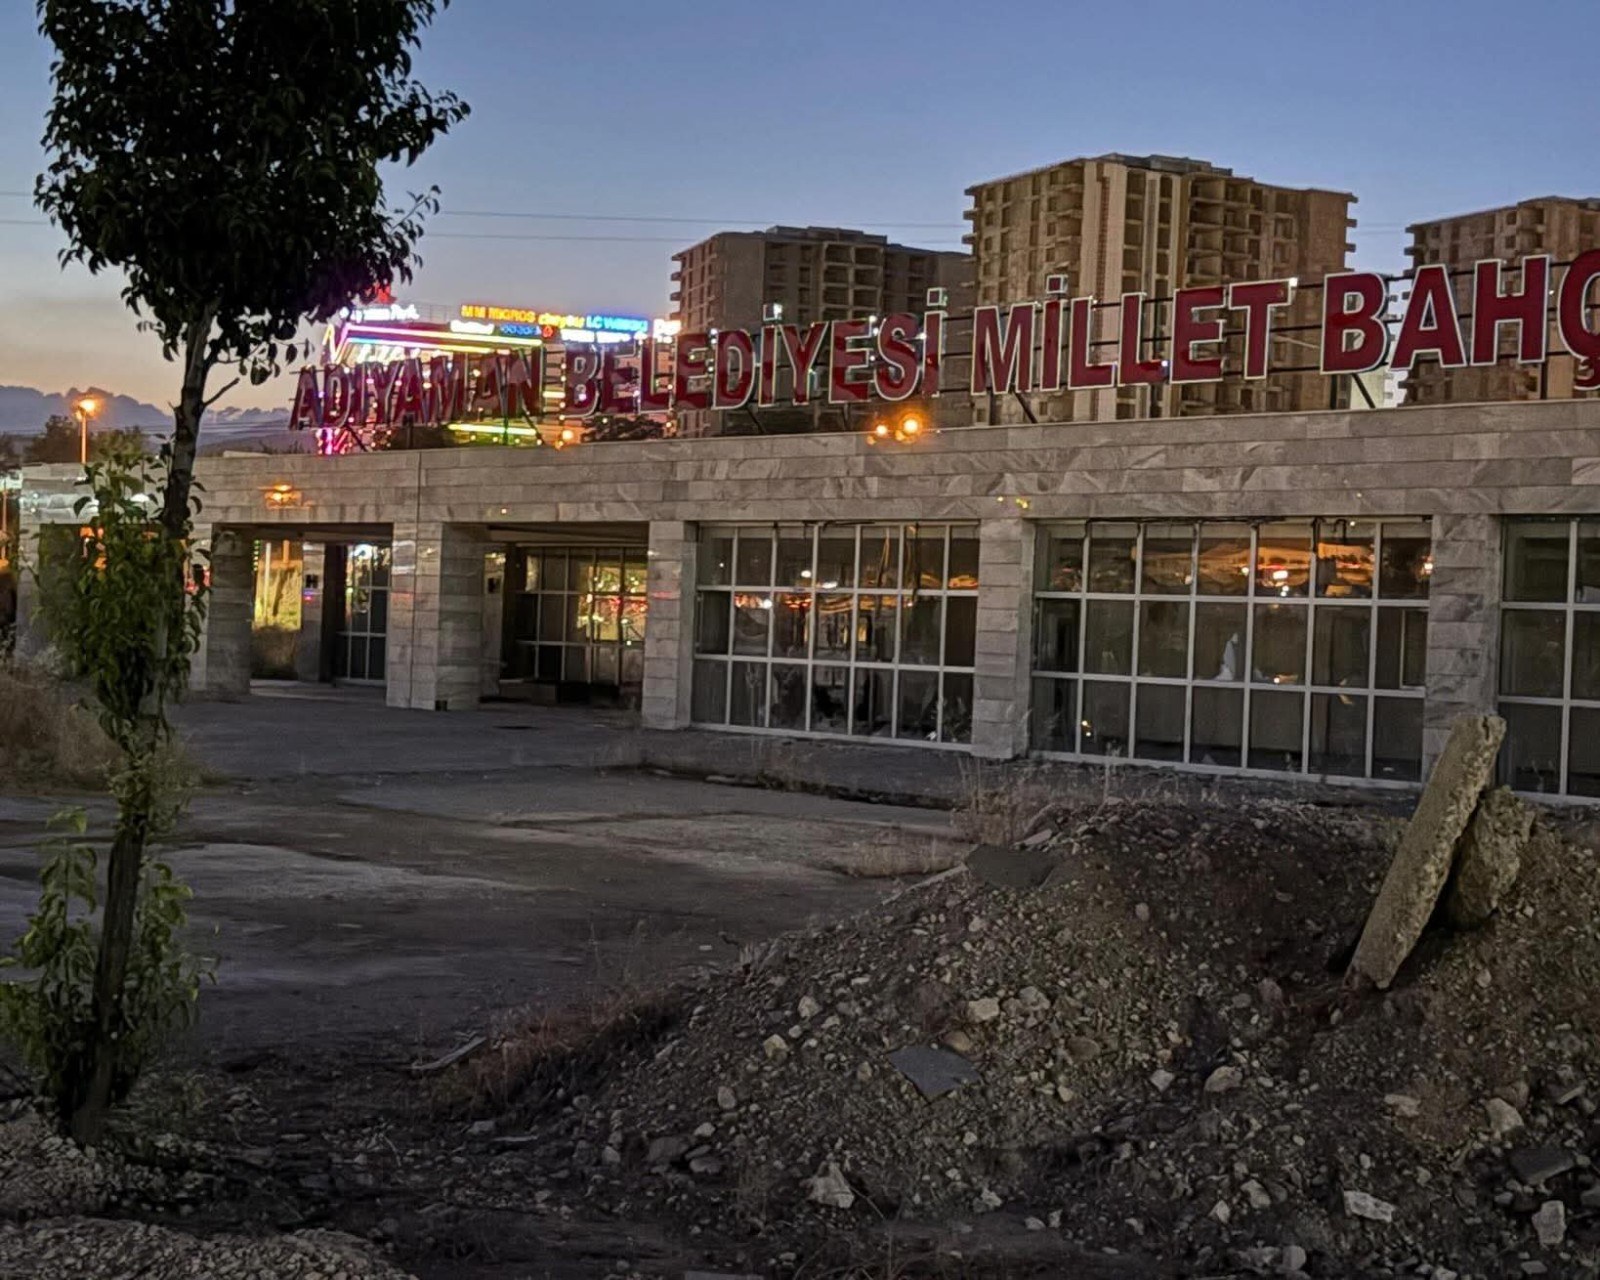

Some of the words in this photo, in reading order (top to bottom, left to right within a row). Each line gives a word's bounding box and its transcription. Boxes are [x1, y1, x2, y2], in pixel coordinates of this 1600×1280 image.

[288, 346, 546, 430] ADIYAMAN
[565, 287, 949, 417] BELEDİYESİ
[971, 274, 1298, 396] MİLLET
